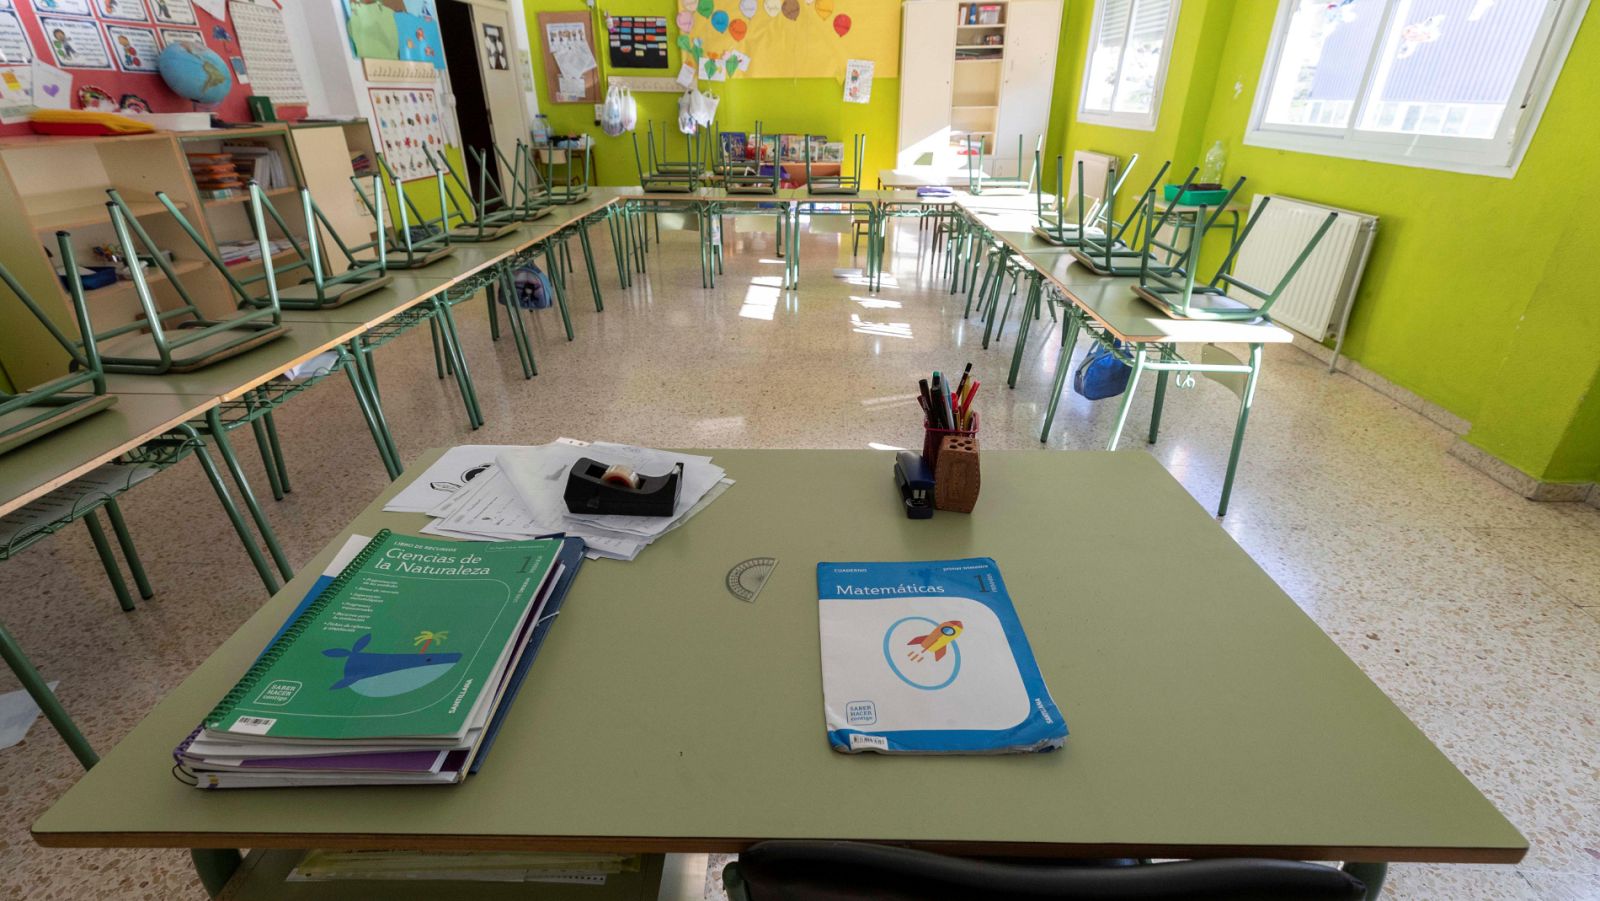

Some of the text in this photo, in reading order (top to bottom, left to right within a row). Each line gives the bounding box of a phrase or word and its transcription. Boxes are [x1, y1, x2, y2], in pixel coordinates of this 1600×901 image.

[386, 547, 482, 564] Ciencias de
[515, 555, 532, 574] 1
[374, 557, 491, 576] la Naturaleza
[836, 584, 945, 596] Matemáticas
[974, 574, 990, 593] 1
[448, 678, 474, 714] SANTILLANA
